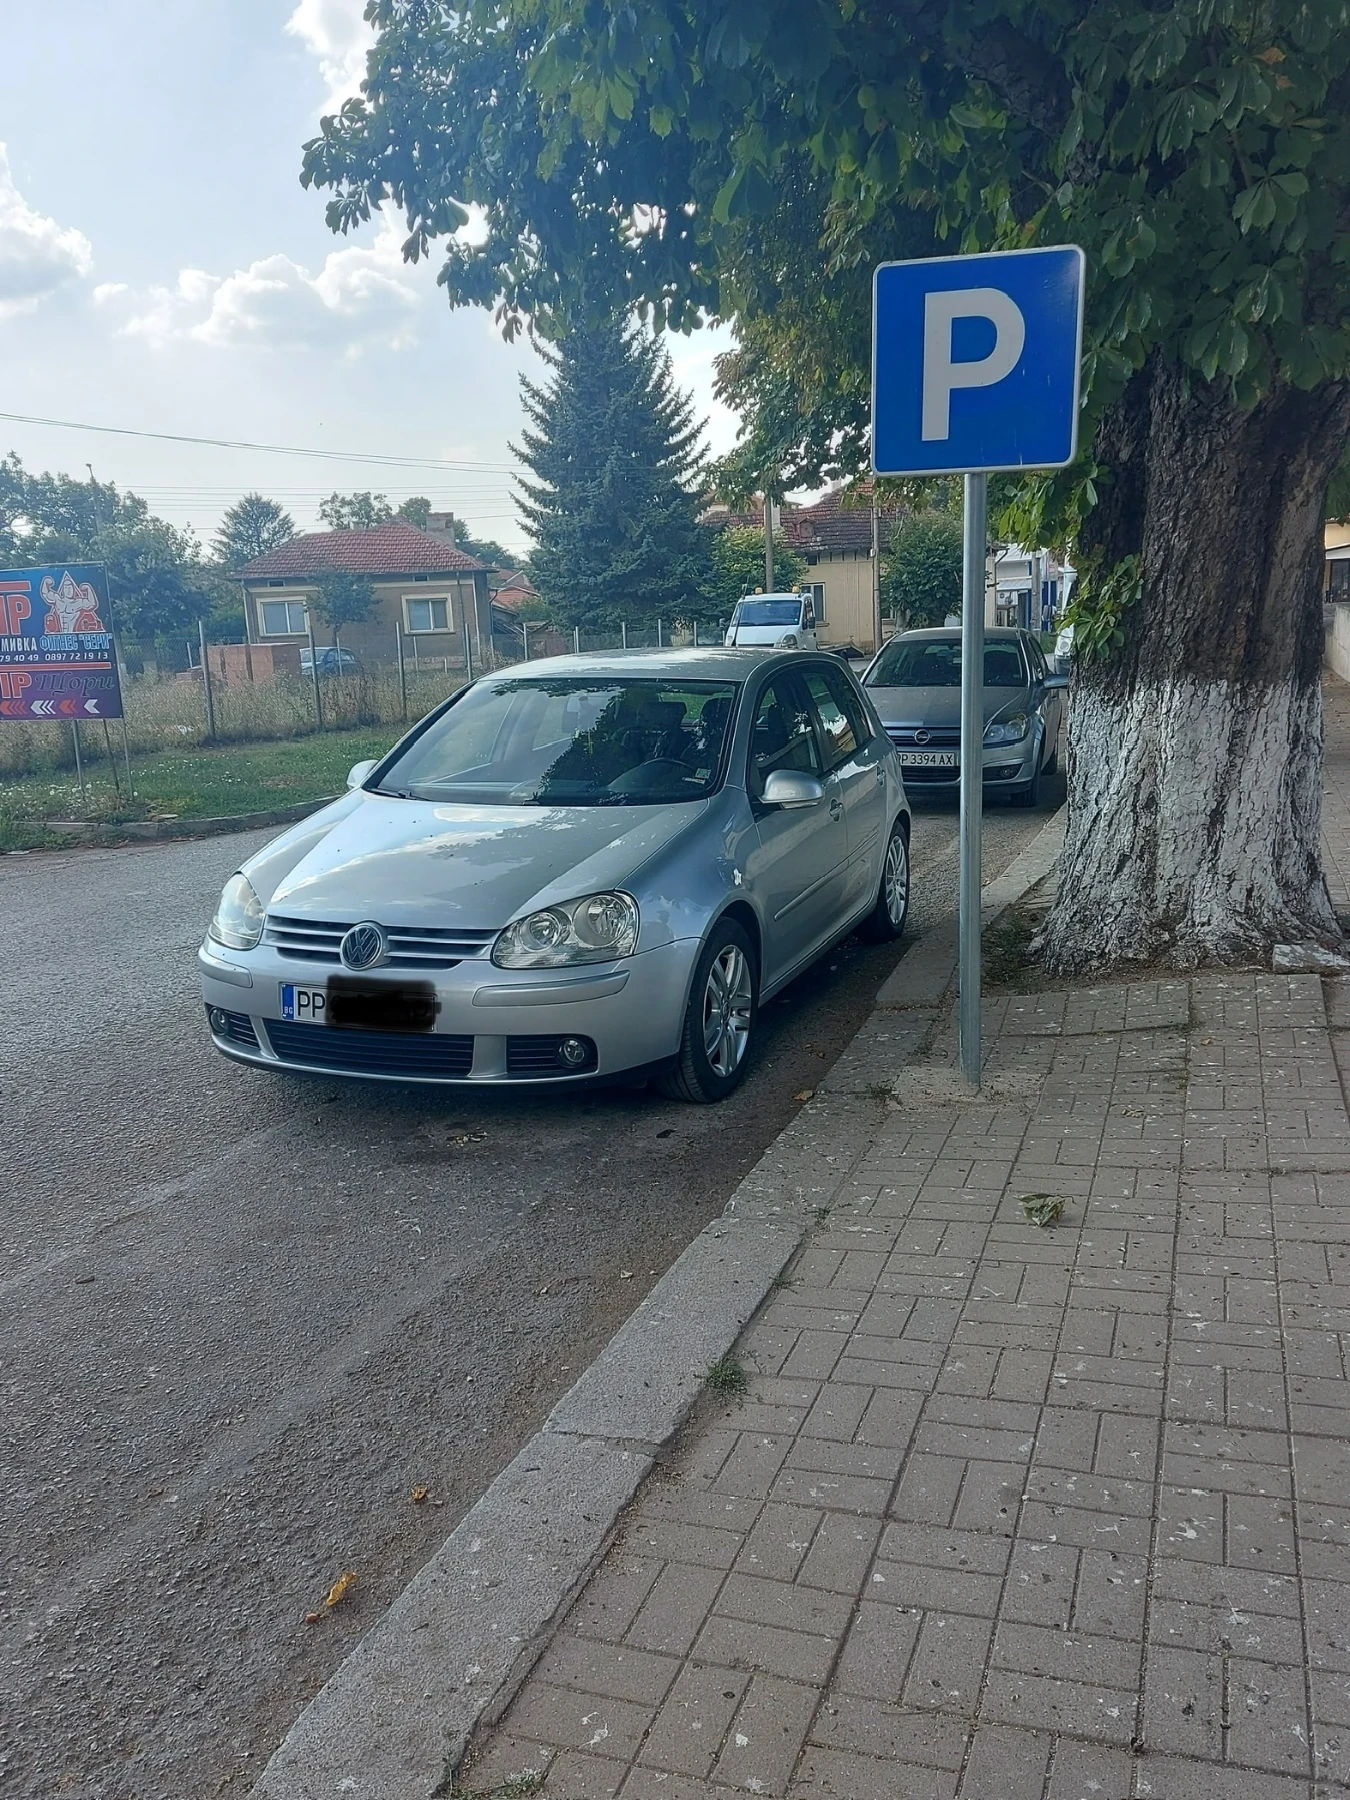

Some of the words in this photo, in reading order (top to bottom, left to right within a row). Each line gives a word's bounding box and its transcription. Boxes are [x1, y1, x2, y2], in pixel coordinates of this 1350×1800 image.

[922, 287, 1025, 441] P
[39, 634, 78, 651] ФИТНЕС
[13, 654, 25, 662] 40
[27, 653, 39, 661] 49
[45, 653, 67, 661] 0897
[69, 652, 81, 660] 72
[84, 652, 94, 660] 19
[97, 651, 108, 659] 13
[910, 754, 936, 765] 3394
[938, 754, 953, 765] AX
[297, 990, 326, 1018] PP
[284, 1006, 293, 1014] BG
